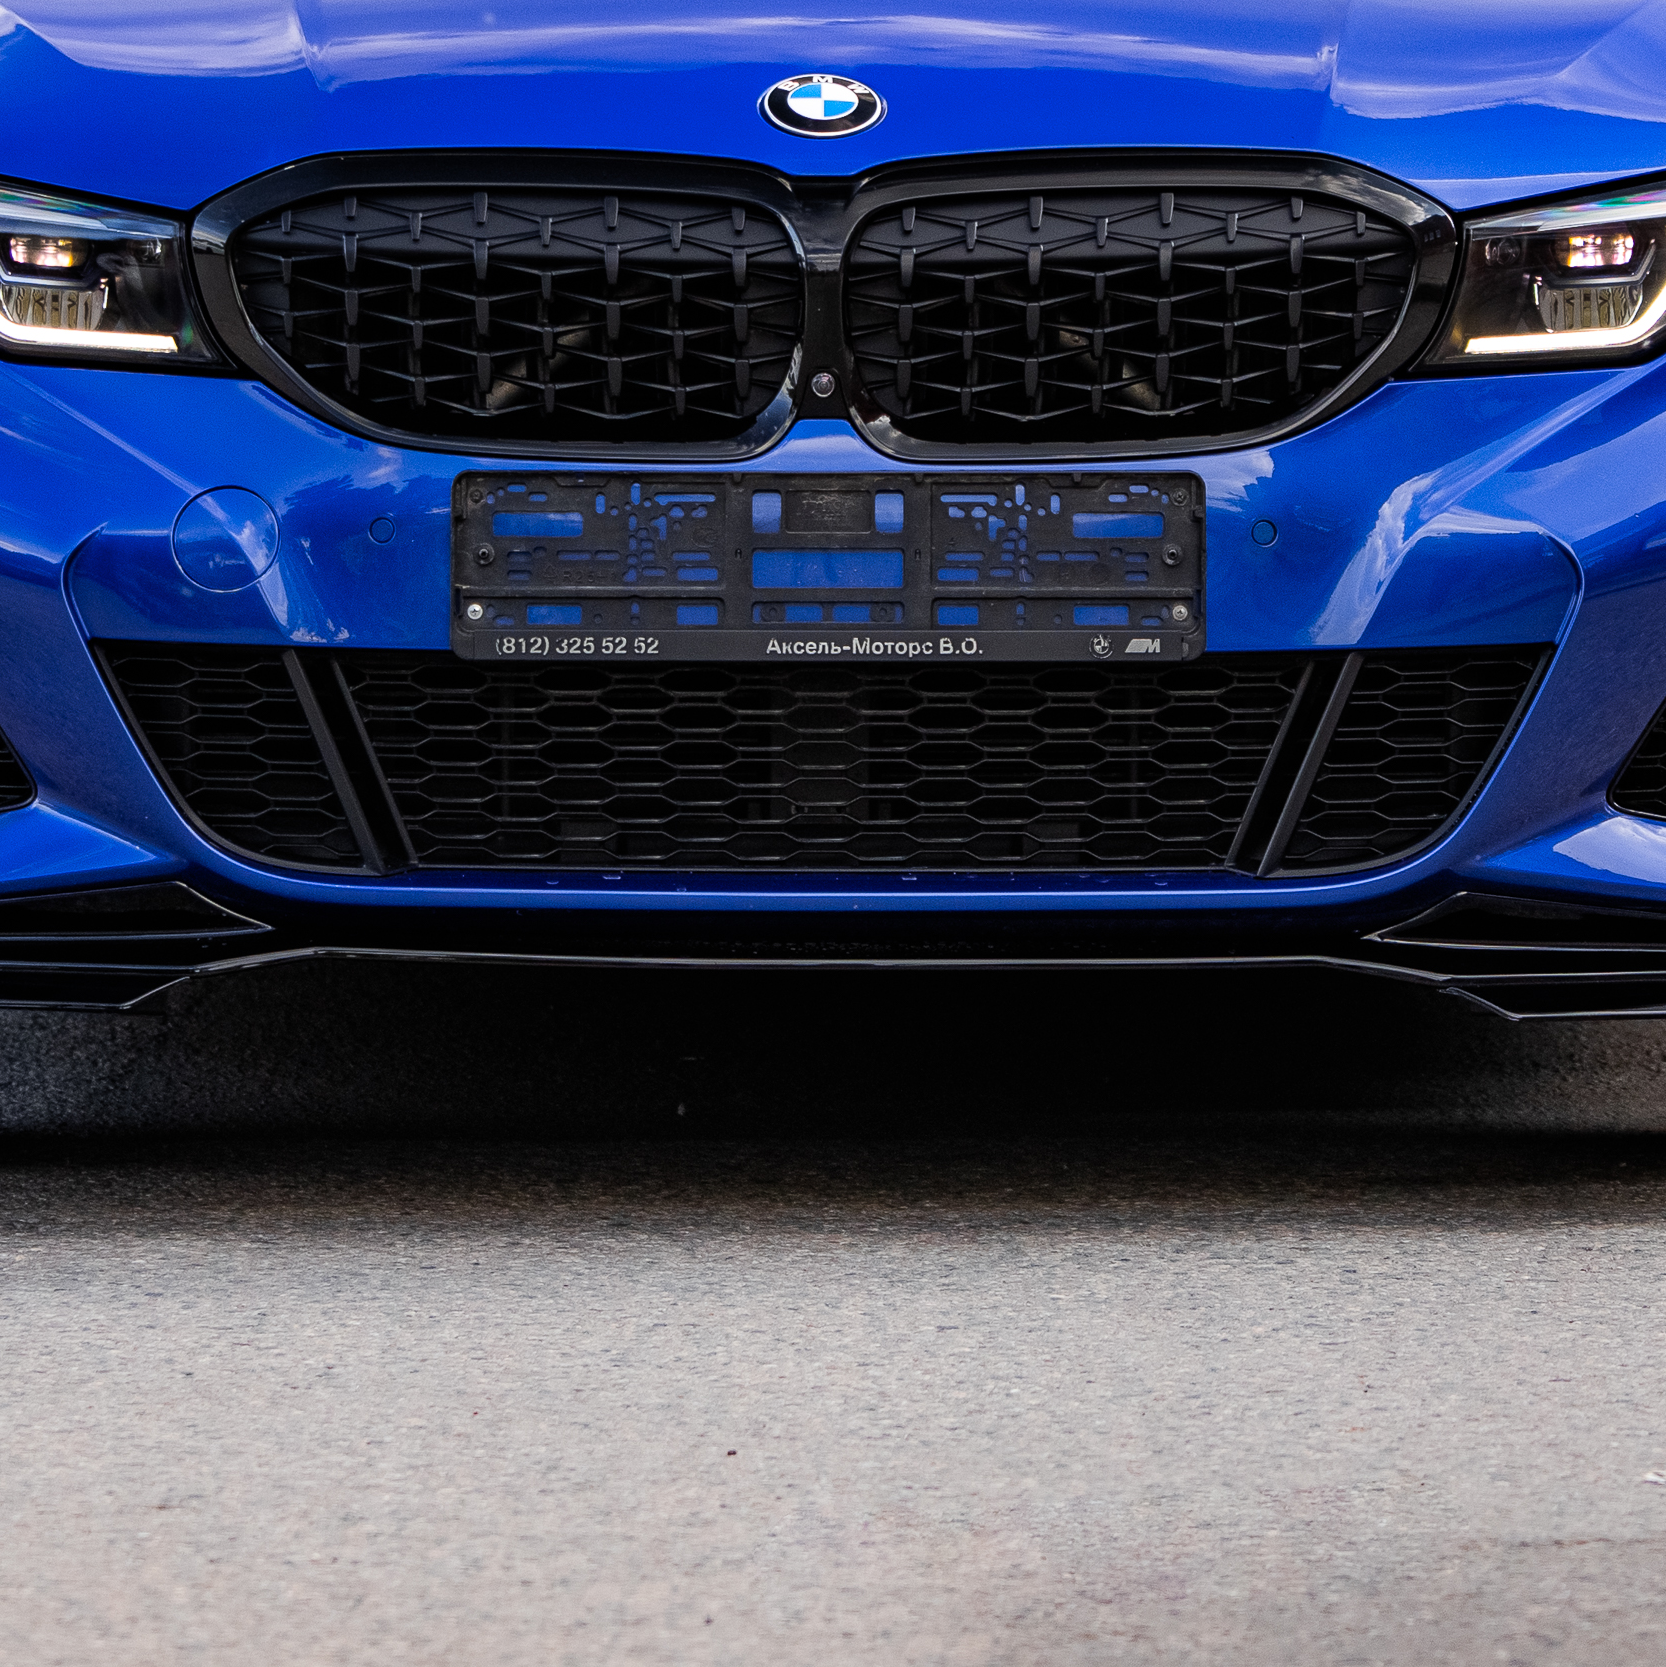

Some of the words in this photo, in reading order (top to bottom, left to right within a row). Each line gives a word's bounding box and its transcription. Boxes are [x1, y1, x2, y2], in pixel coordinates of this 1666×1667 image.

[777, 75, 870, 94] BMW
[495, 636, 549, 655] (812)
[555, 636, 595, 654] 325
[601, 636, 627, 654] 52
[634, 636, 659, 654] 52
[766, 637, 933, 657] Аксель-Моторс
[939, 637, 983, 655] В.О.
